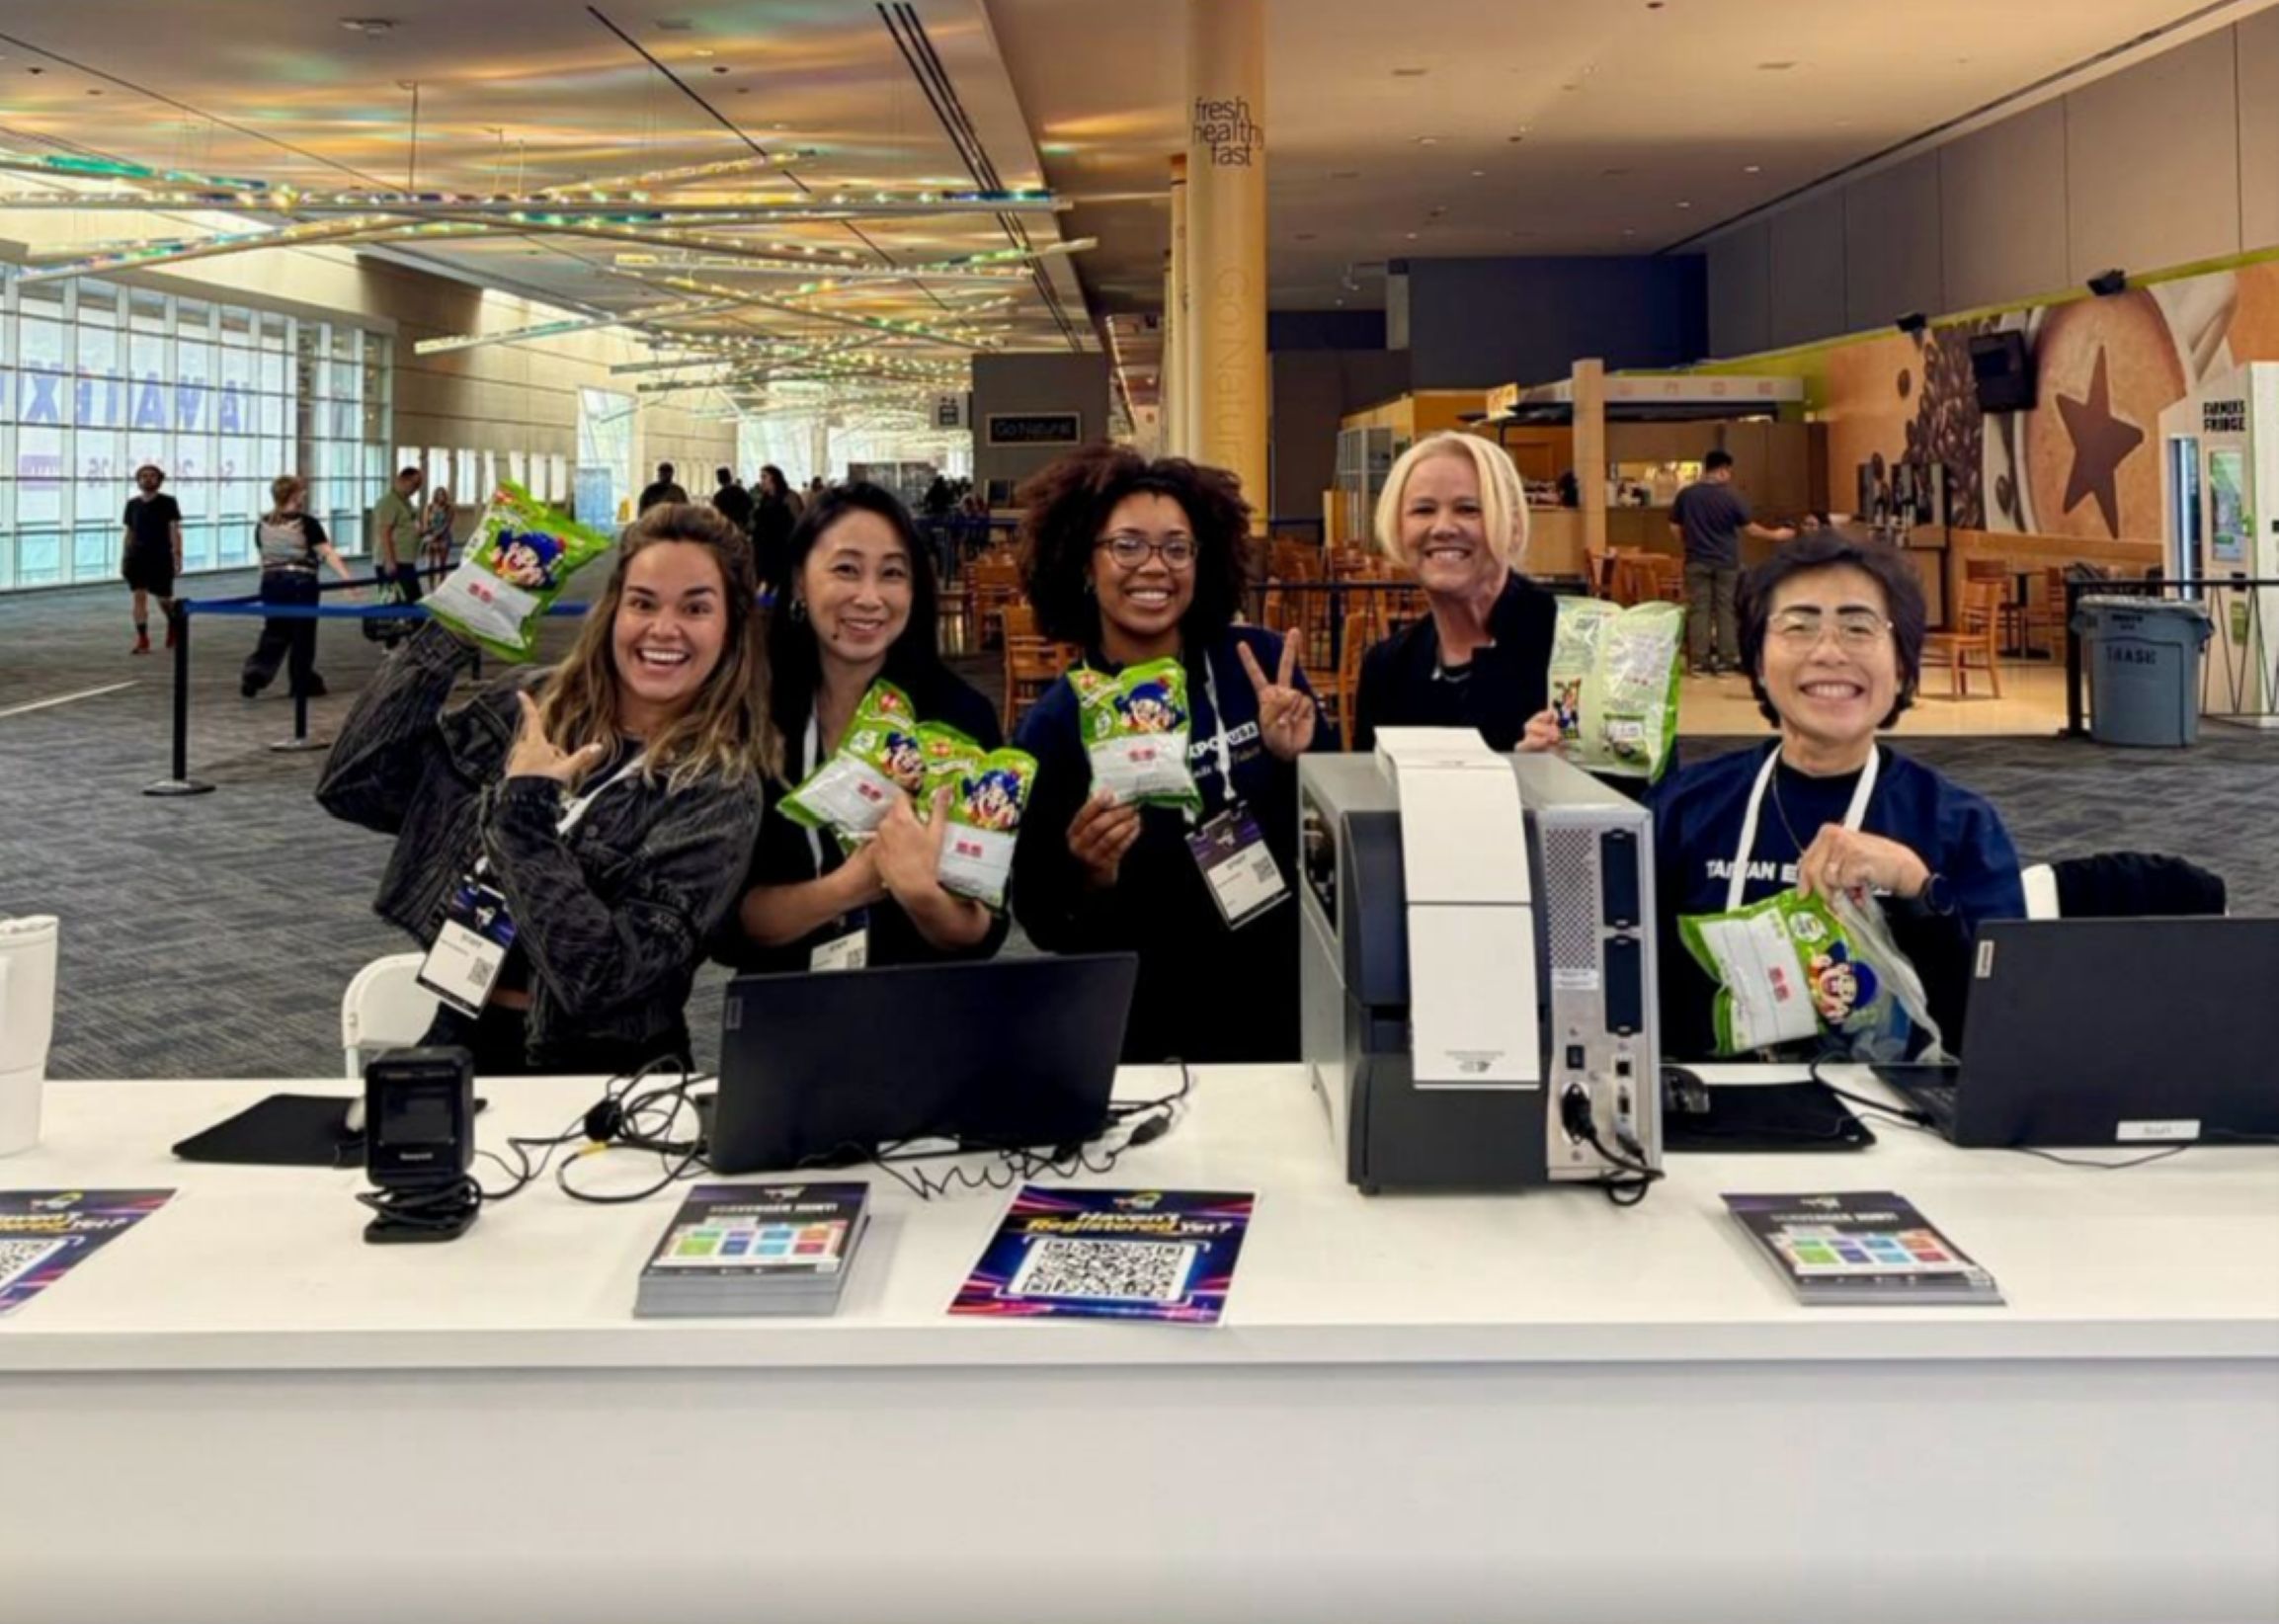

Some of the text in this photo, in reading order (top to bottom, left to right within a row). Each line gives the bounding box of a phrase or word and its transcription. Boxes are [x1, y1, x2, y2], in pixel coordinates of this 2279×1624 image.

[1195, 96, 1250, 120] fresh
[1211, 141, 1253, 168] fast
[1216, 339, 1251, 471] Natura
[2105, 644, 2157, 666] TRASH
[1705, 858, 1776, 882] TAIAN
